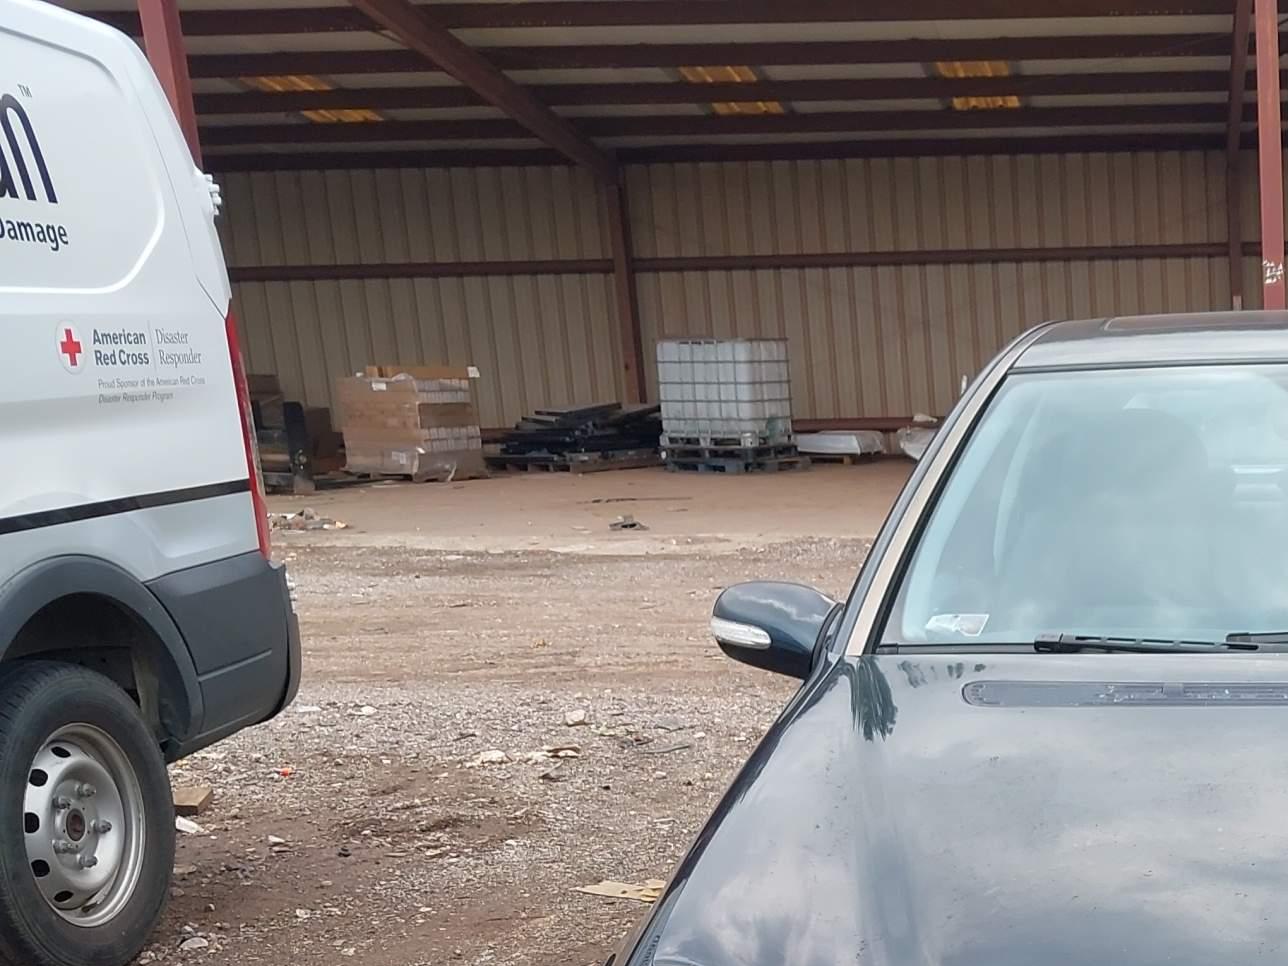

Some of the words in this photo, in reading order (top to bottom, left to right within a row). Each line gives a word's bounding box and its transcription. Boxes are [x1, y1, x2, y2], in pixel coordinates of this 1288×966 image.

[18, 83, 32, 98] TM
[92, 329, 146, 345] American
[155, 328, 188, 344] Disaster
[94, 349, 117, 366] Red
[118, 349, 149, 365] Cross
[158, 347, 201, 368] Responder
